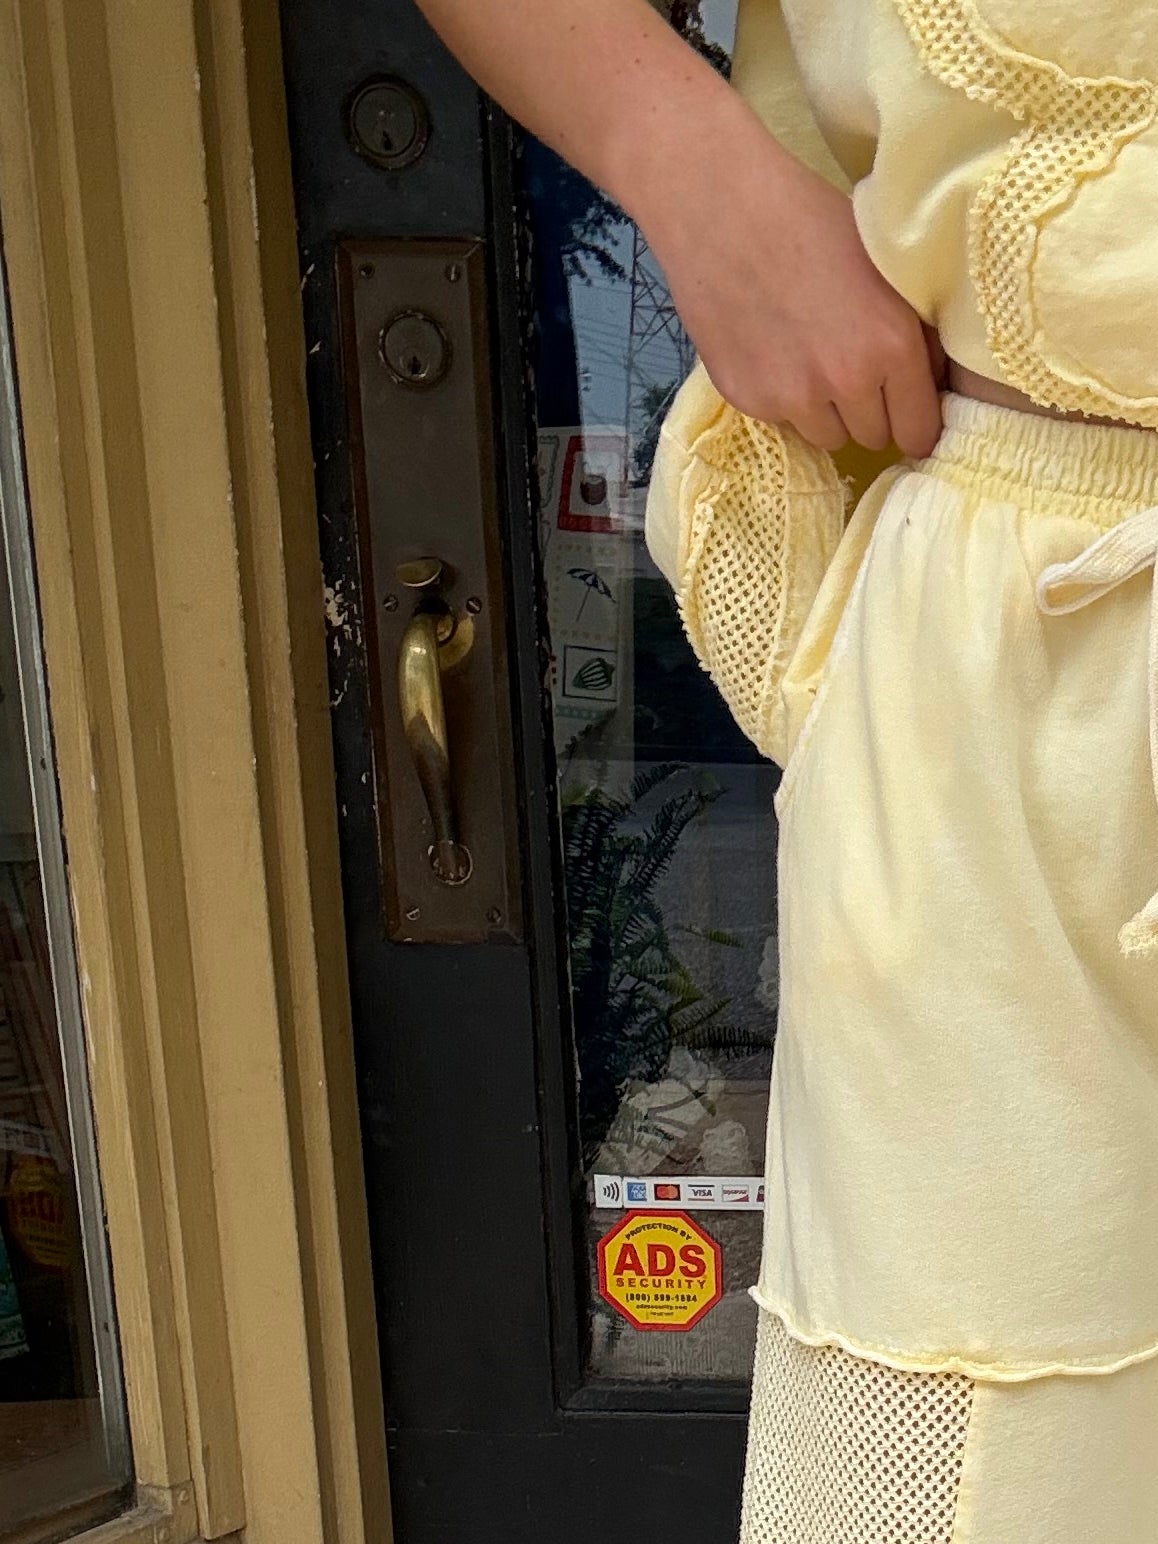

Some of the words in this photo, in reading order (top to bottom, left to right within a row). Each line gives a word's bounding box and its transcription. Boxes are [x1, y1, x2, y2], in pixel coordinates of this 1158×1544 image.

[692, 1189, 712, 1197] VISA
[624, 1222, 679, 1240] PROTECTION
[679, 1228, 693, 1241] BY
[613, 1243, 707, 1278] ADS
[616, 1277, 707, 1289] SECURITY
